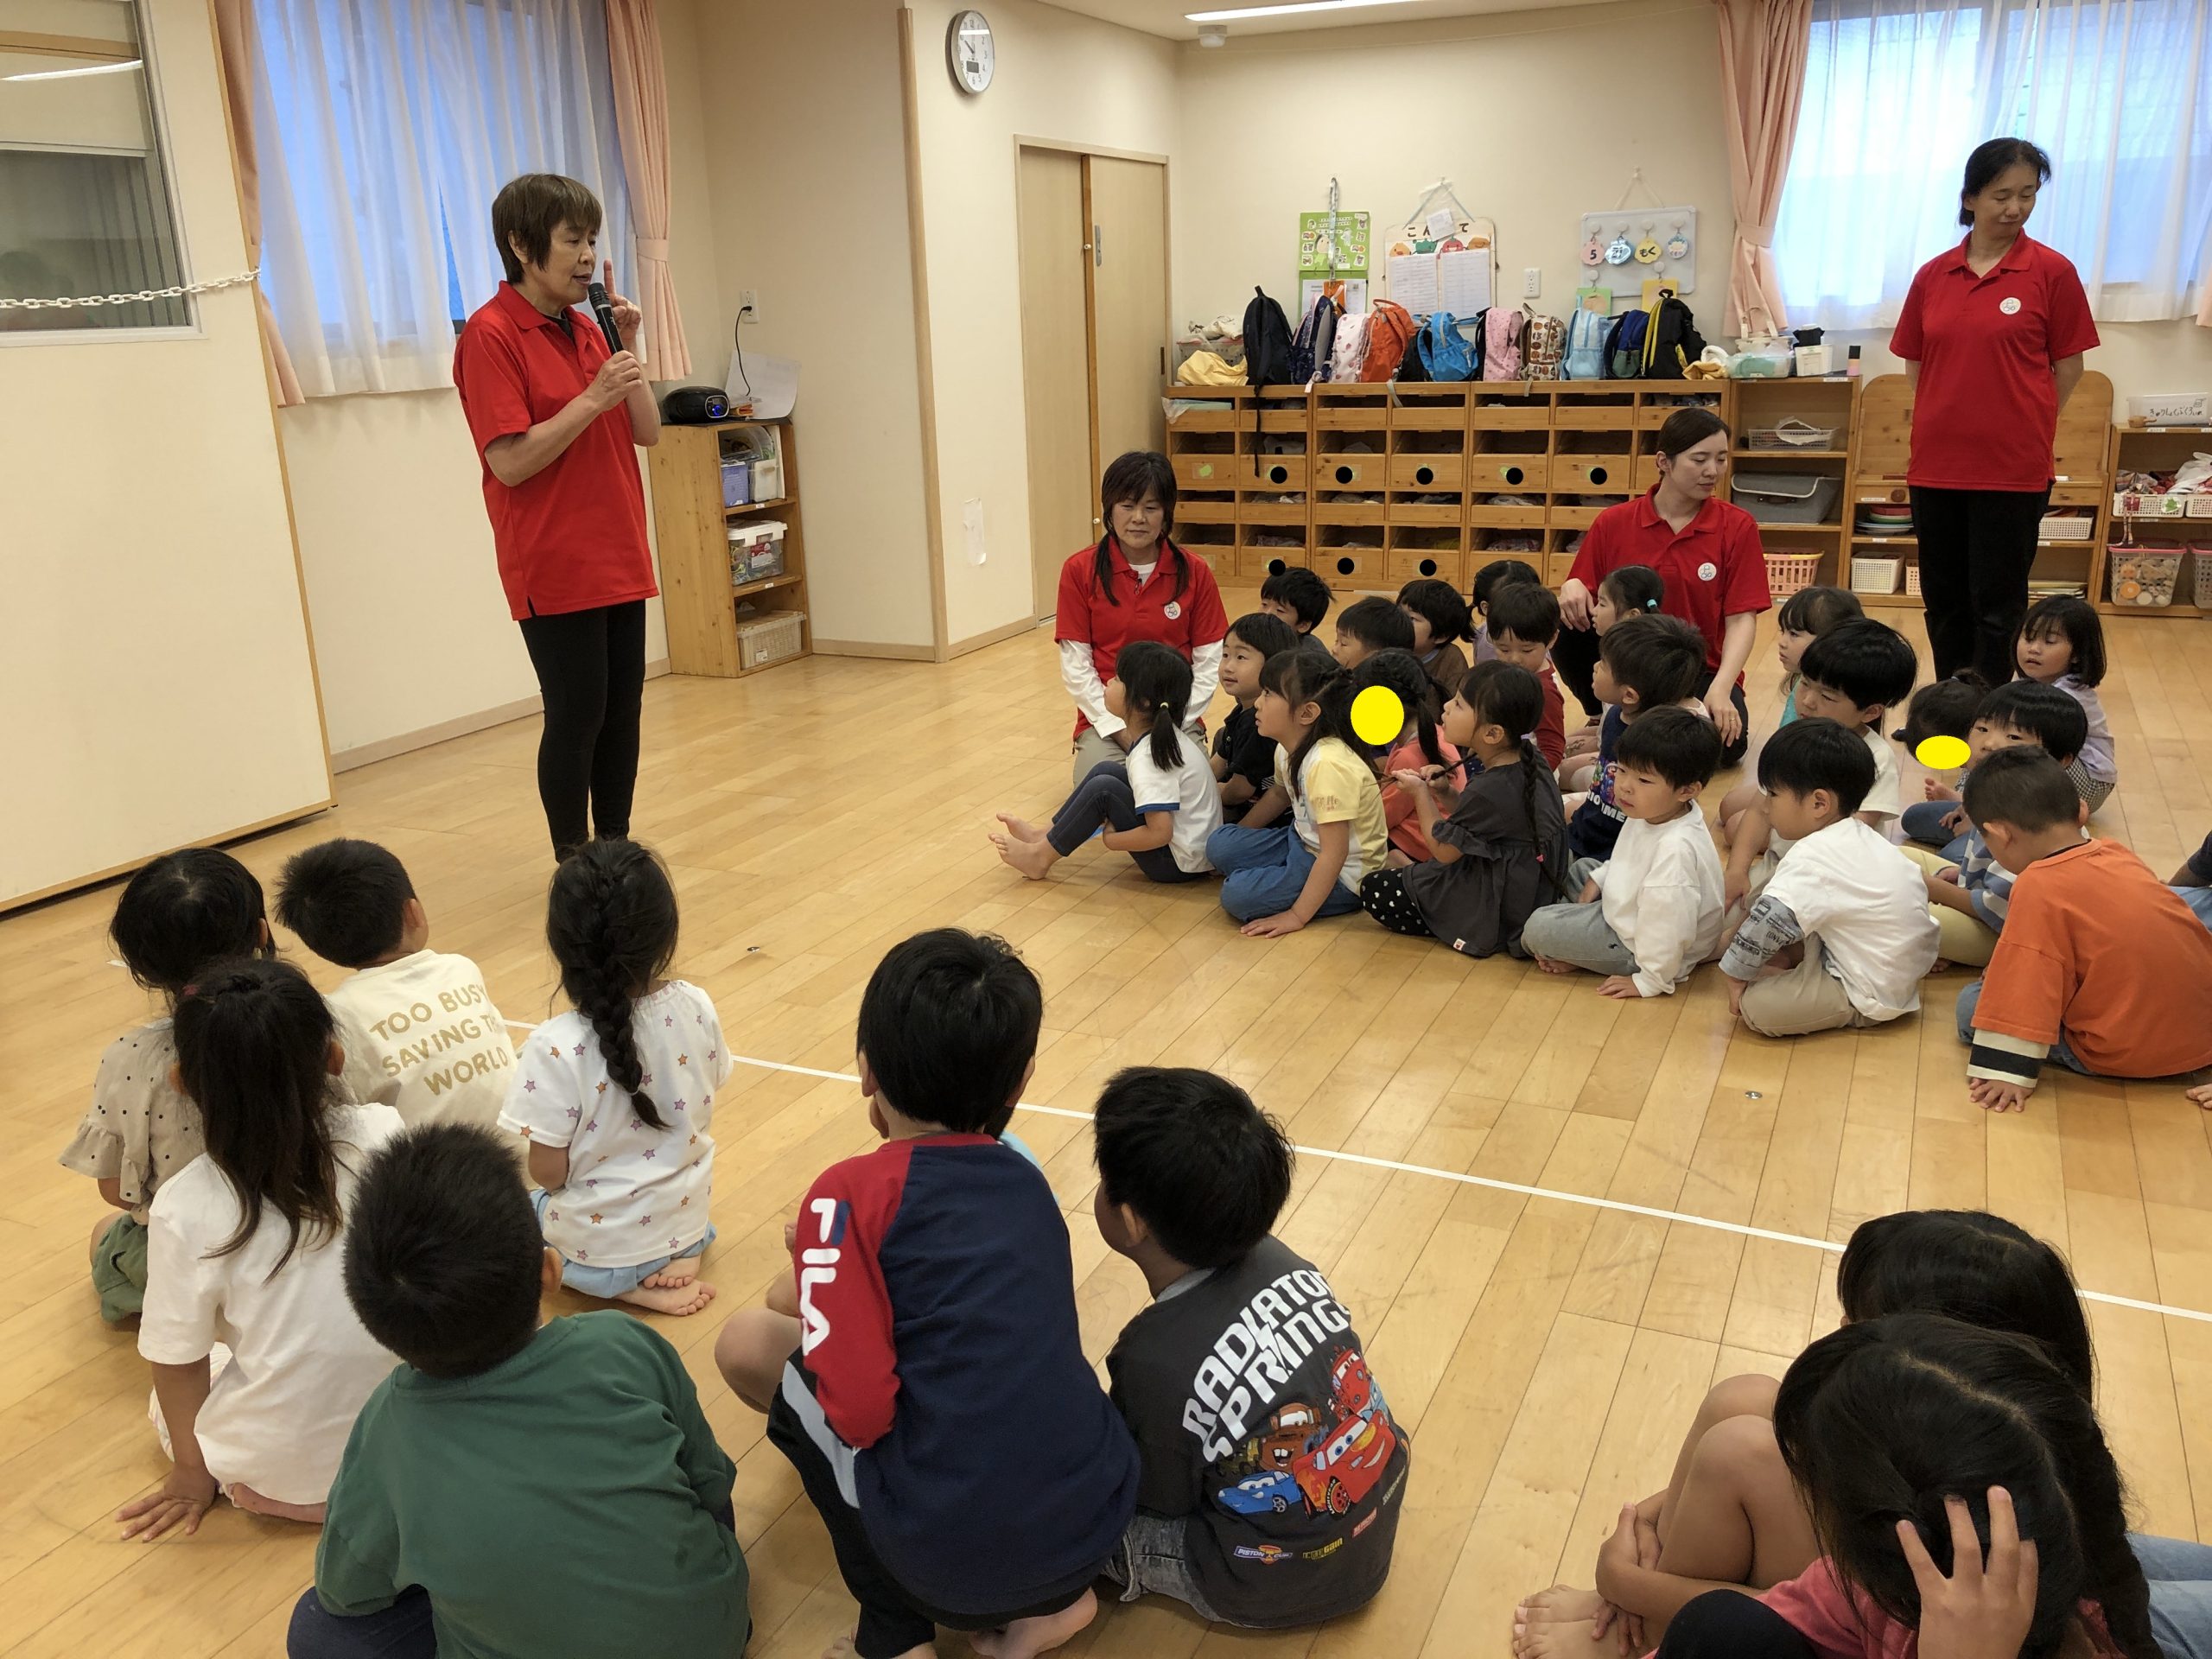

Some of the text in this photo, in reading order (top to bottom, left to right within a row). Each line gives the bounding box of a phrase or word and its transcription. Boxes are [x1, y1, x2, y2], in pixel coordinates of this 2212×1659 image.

[1408, 223, 1469, 238] こんて
[1590, 249, 1597, 259] 5
[1640, 246, 1656, 257] もく
[369, 984, 486, 1040] TOO BUSY
[382, 1018, 481, 1077] SAVING
[423, 1046, 508, 1096] WORLD
[800, 1198, 851, 1357] FILA
[1237, 1548, 1265, 1557] PISTON
